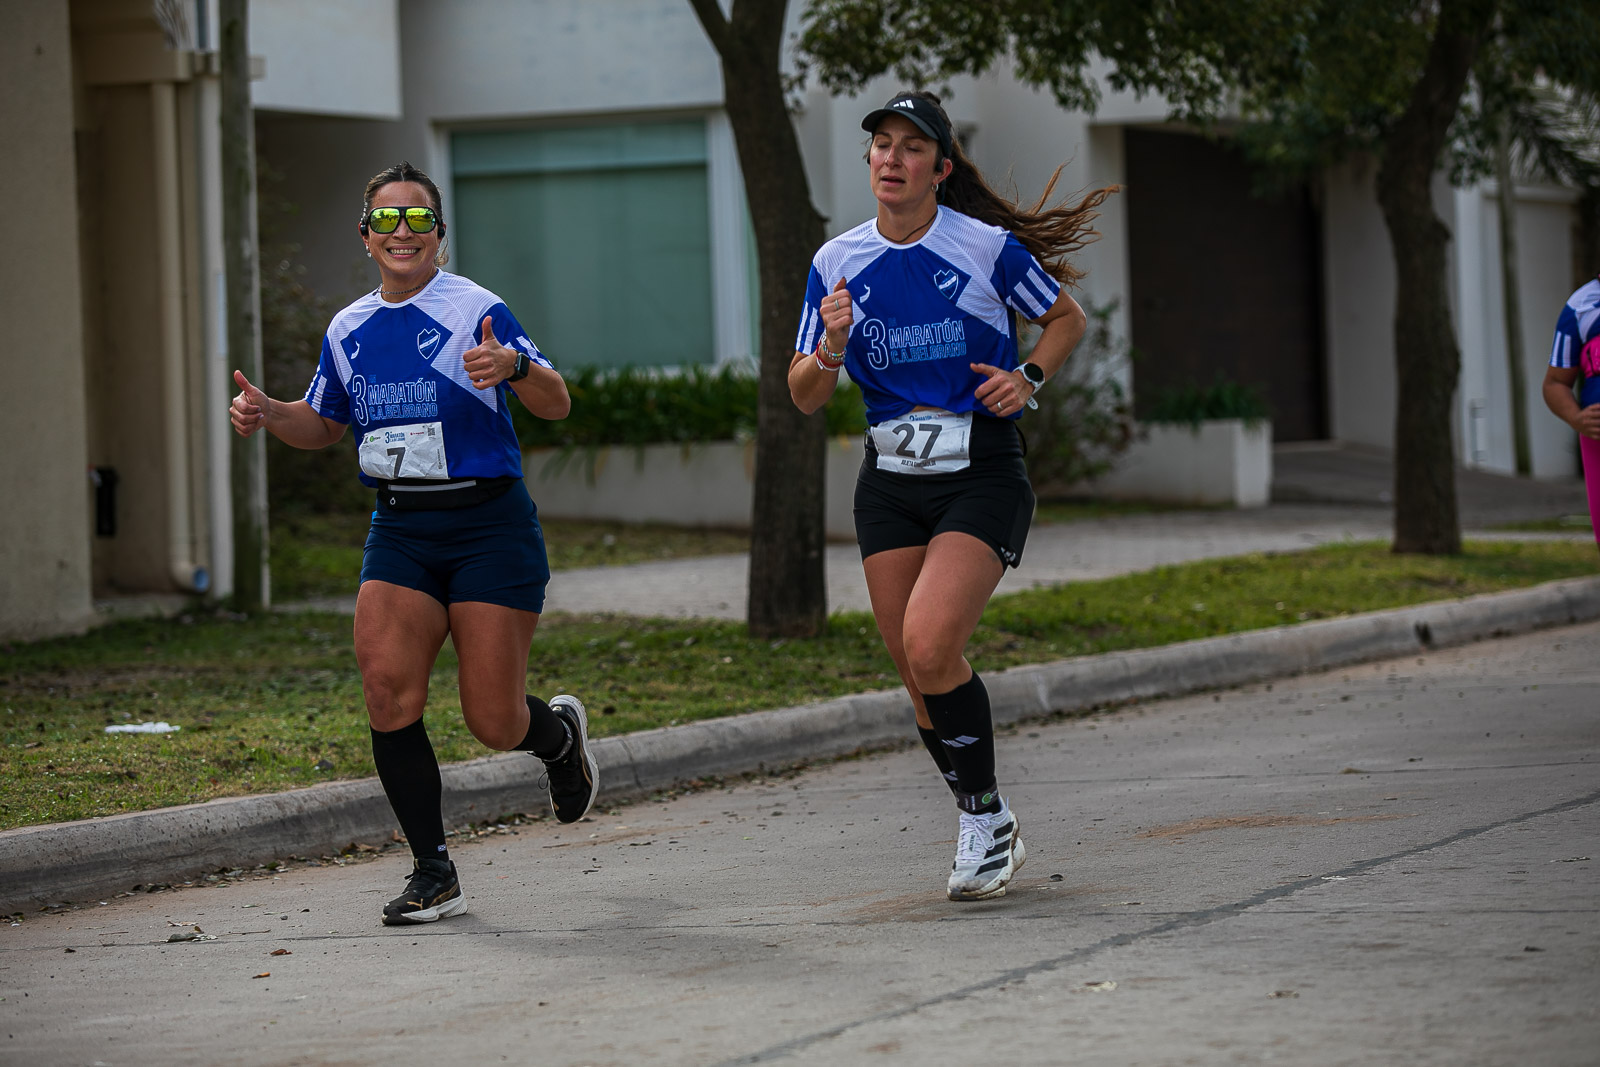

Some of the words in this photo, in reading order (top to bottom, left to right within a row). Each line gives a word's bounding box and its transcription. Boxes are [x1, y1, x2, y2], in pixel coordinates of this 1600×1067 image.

[863, 318, 889, 370] 3
[889, 317, 965, 349] MARATÓN
[352, 374, 369, 426] 3
[368, 377, 437, 405] MARATÓN
[385, 431, 390, 444] 3
[892, 423, 942, 459] 27
[387, 446, 406, 478] 7
